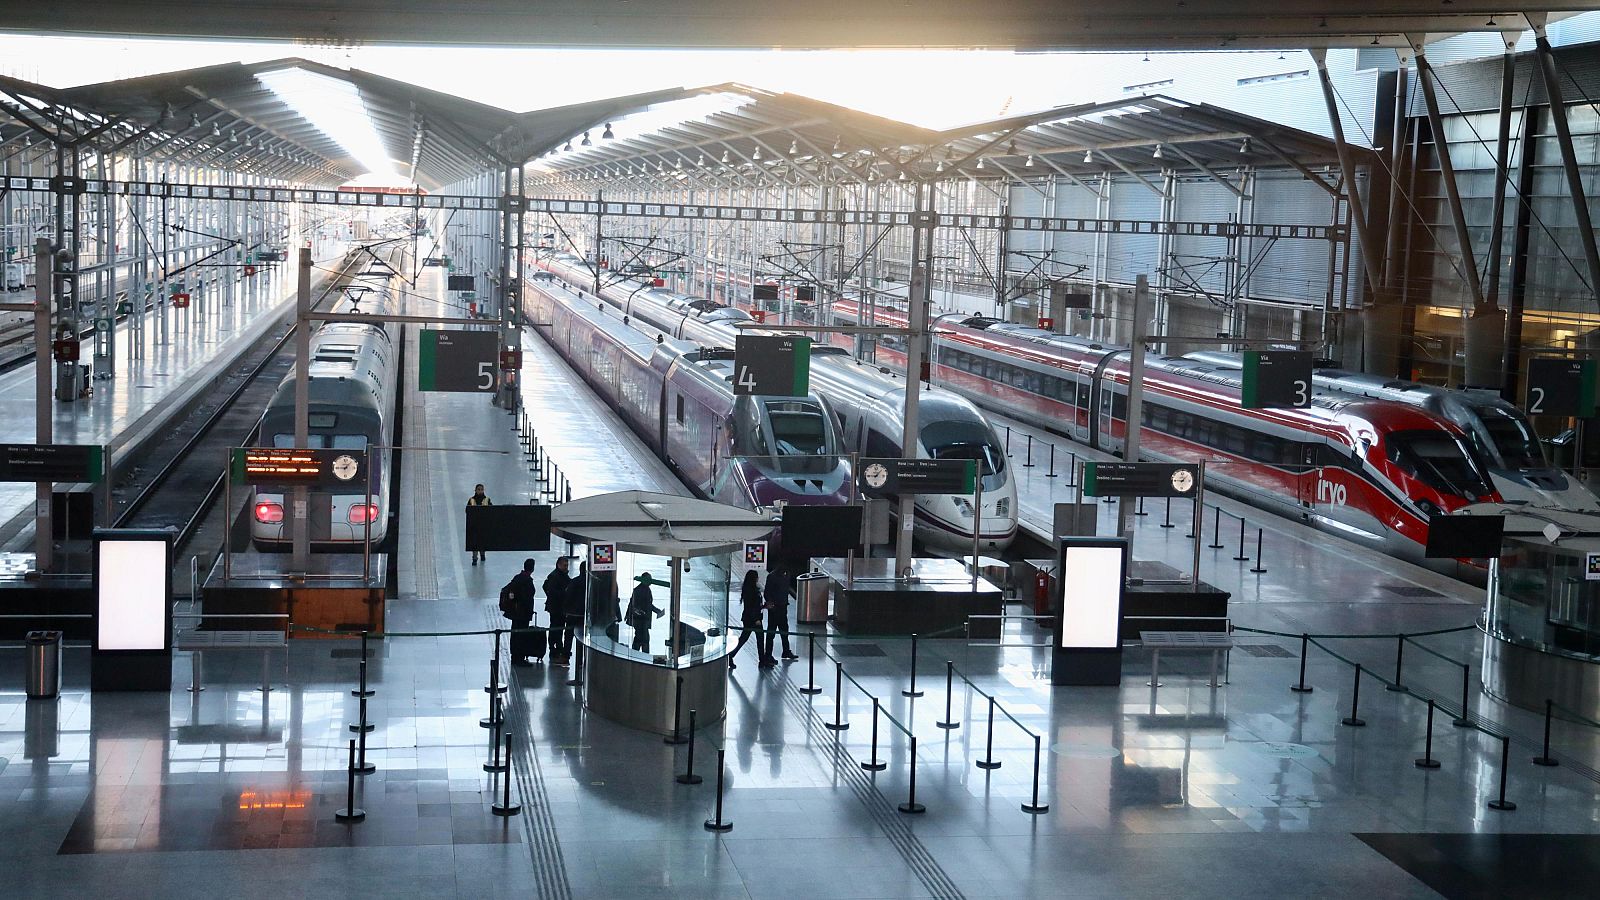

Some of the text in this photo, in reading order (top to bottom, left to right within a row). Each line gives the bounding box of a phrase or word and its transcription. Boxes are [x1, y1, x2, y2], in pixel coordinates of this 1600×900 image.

[478, 362, 493, 389] 5
[738, 365, 757, 392] 4
[1293, 380, 1307, 407] 3
[1530, 387, 1545, 413] 2
[1317, 468, 1347, 512] iryo
